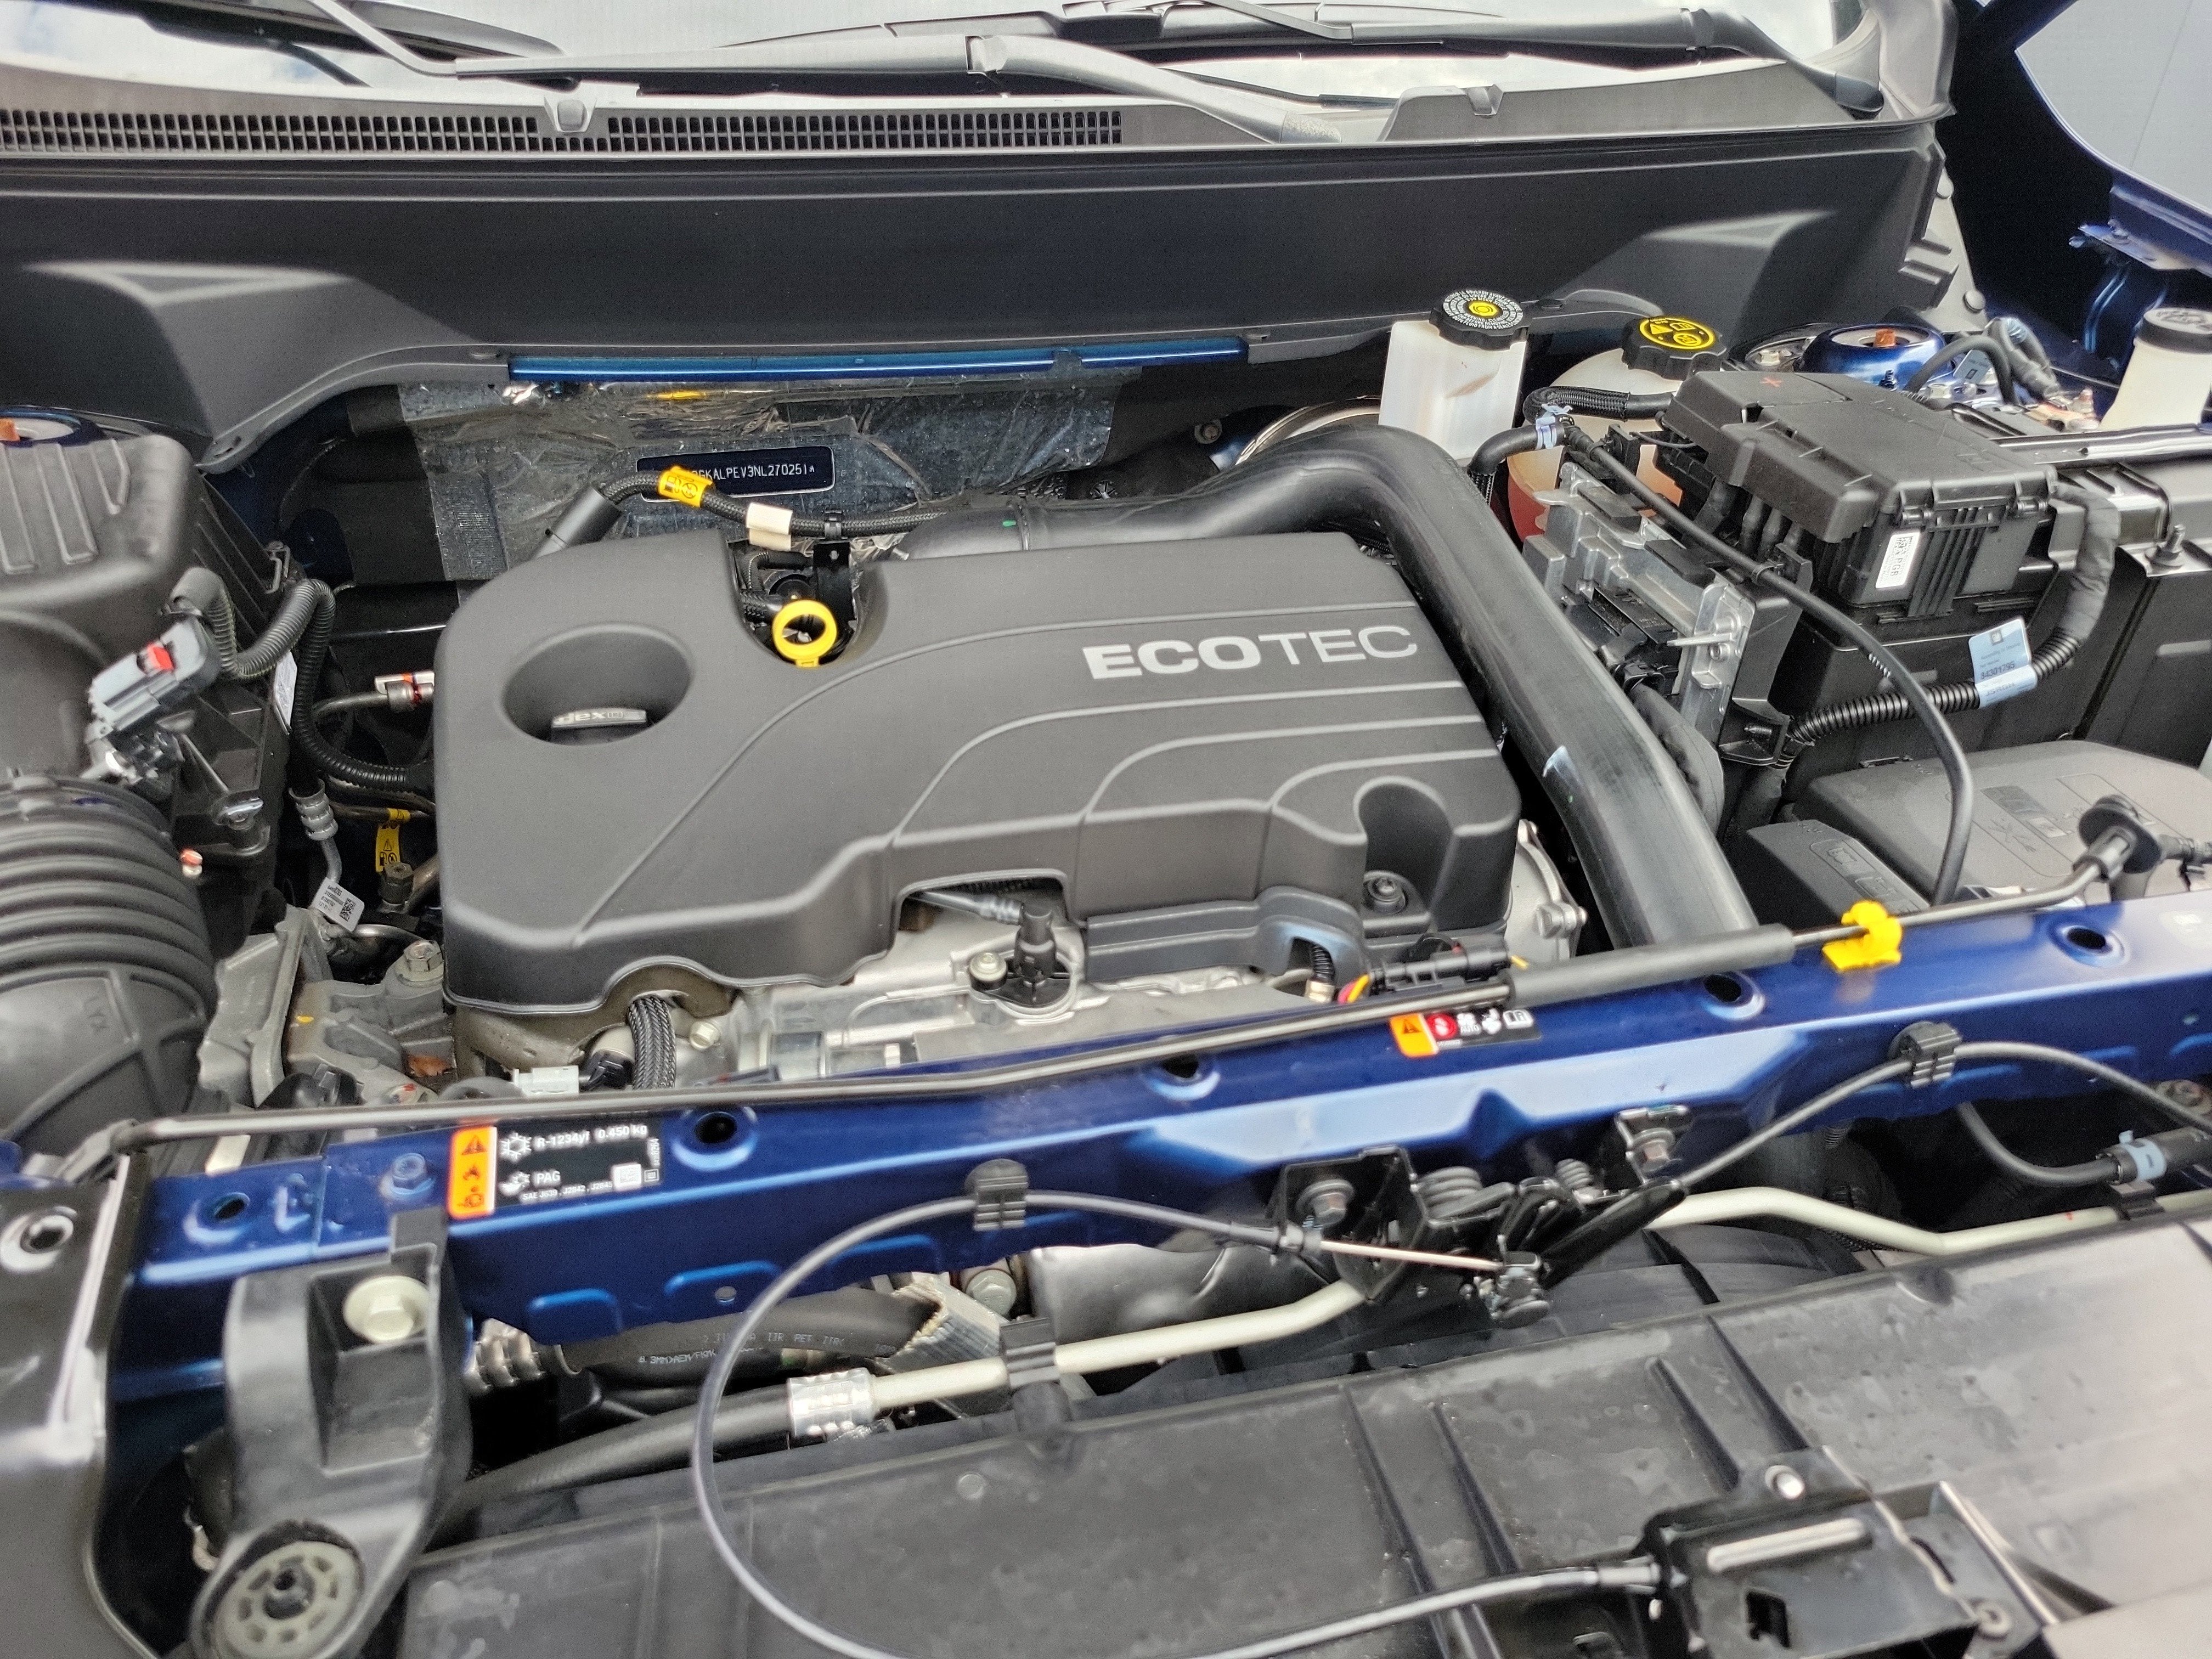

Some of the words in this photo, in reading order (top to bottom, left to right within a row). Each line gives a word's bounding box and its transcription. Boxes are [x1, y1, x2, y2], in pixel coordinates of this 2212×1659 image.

[1891, 557, 1903, 576] PGB
[1083, 626, 1417, 679] ECOTEC
[536, 1131, 590, 1147] R-1234yf
[598, 1126, 630, 1139] 0.450
[631, 1124, 647, 1135] kg
[537, 1170, 561, 1183] PAG
[523, 1192, 538, 1200] SAE
[795, 1334, 813, 1342] PET
